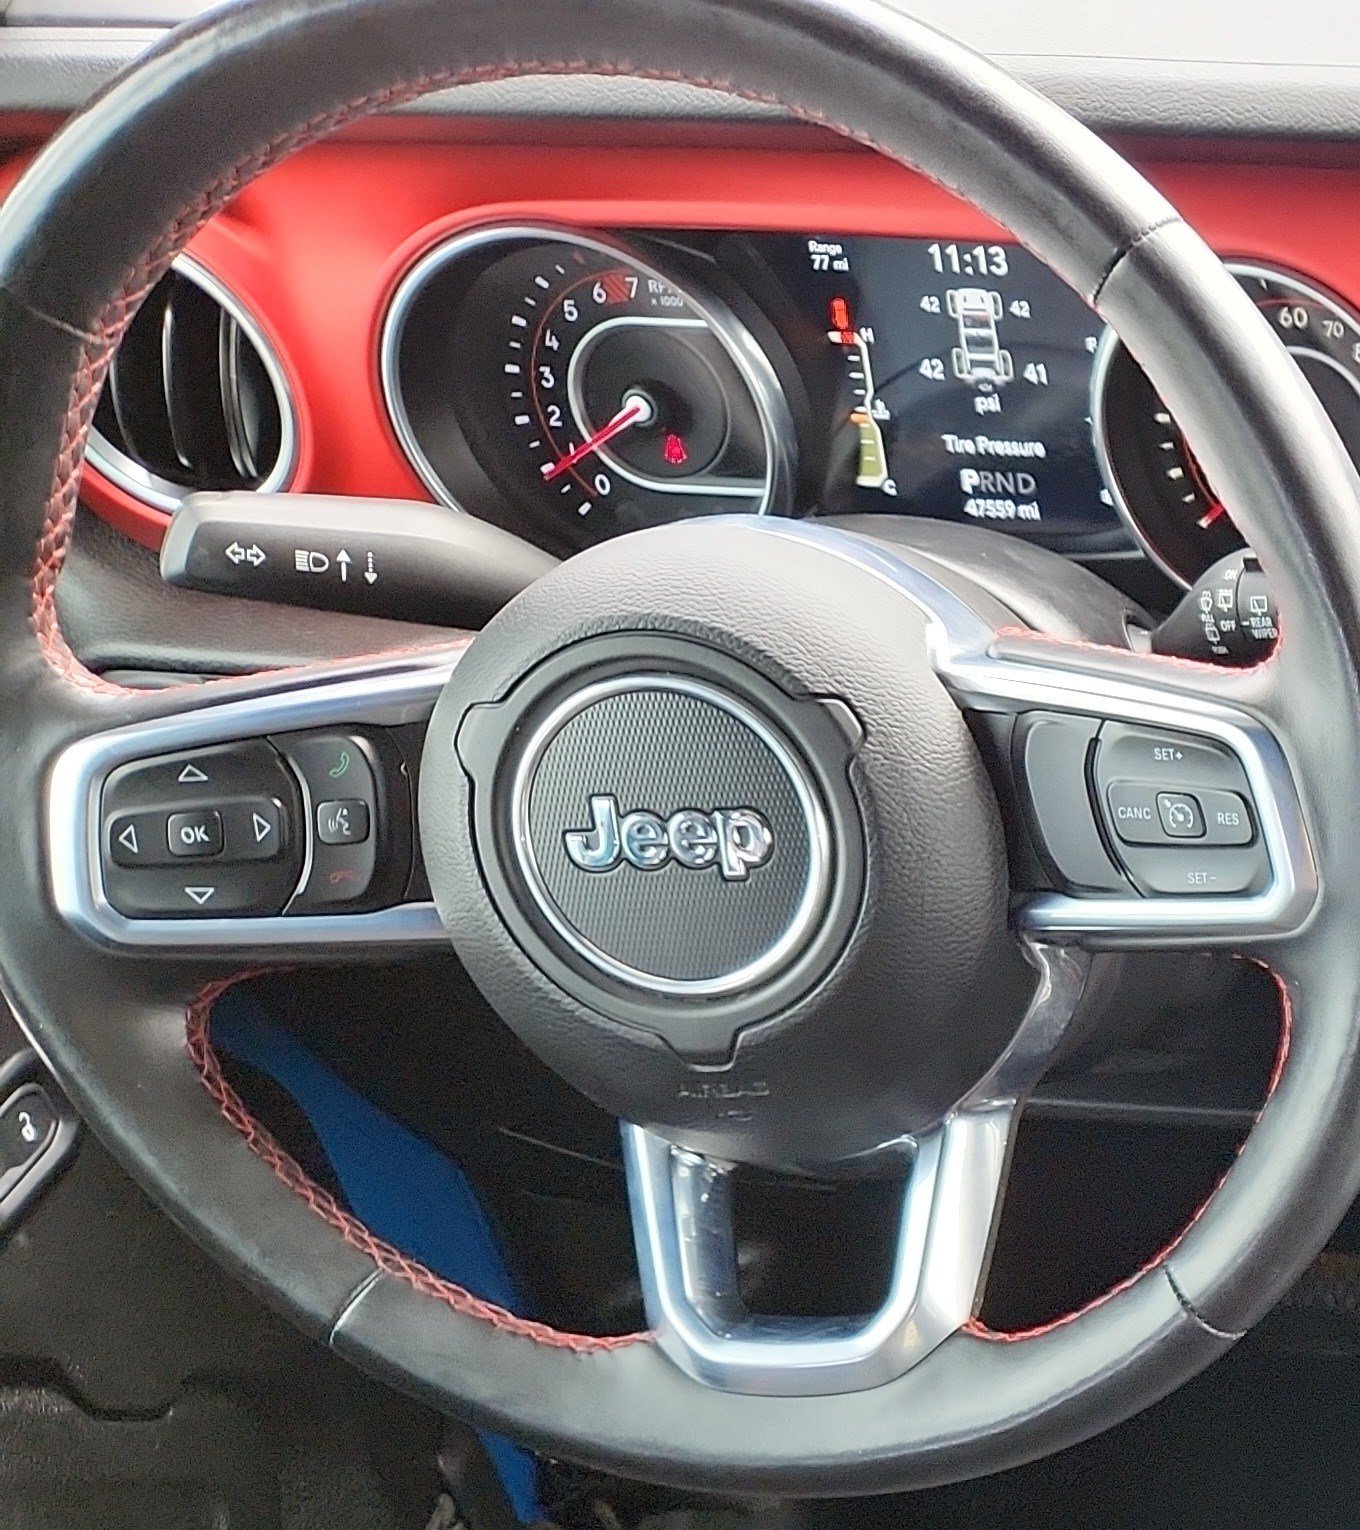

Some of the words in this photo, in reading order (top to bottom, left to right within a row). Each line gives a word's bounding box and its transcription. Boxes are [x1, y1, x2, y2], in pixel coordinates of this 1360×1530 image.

[808, 241, 842, 255] Range
[811, 255, 830, 271] 77
[832, 258, 849, 272] mi
[928, 244, 1009, 276] 11:13
[592, 282, 607, 304] 6
[624, 277, 638, 299] 7
[563, 299, 579, 322] 5
[920, 296, 941, 314] 42
[1009, 300, 1031, 319] 42
[1279, 306, 1308, 329] 60
[545, 329, 559, 351] 4
[860, 327, 875, 344] H
[1322, 320, 1344, 338] 70
[539, 365, 555, 389] 3
[919, 358, 945, 381] 42
[1022, 363, 1049, 386] 41
[547, 405, 563, 428] 2
[974, 394, 1001, 417] psi
[941, 434, 975, 455] Tire
[975, 435, 1046, 459] Pressure
[594, 473, 611, 496] 0
[960, 468, 1036, 495] PRND
[964, 498, 1015, 520] 47559
[1016, 500, 1041, 521] mi
[1224, 568, 1238, 581] ON
[1220, 620, 1236, 632] OFF
[1118, 806, 1151, 819] CANC
[1217, 812, 1239, 826] RES
[180, 825, 210, 845] OK
[564, 795, 774, 881] Jeep
